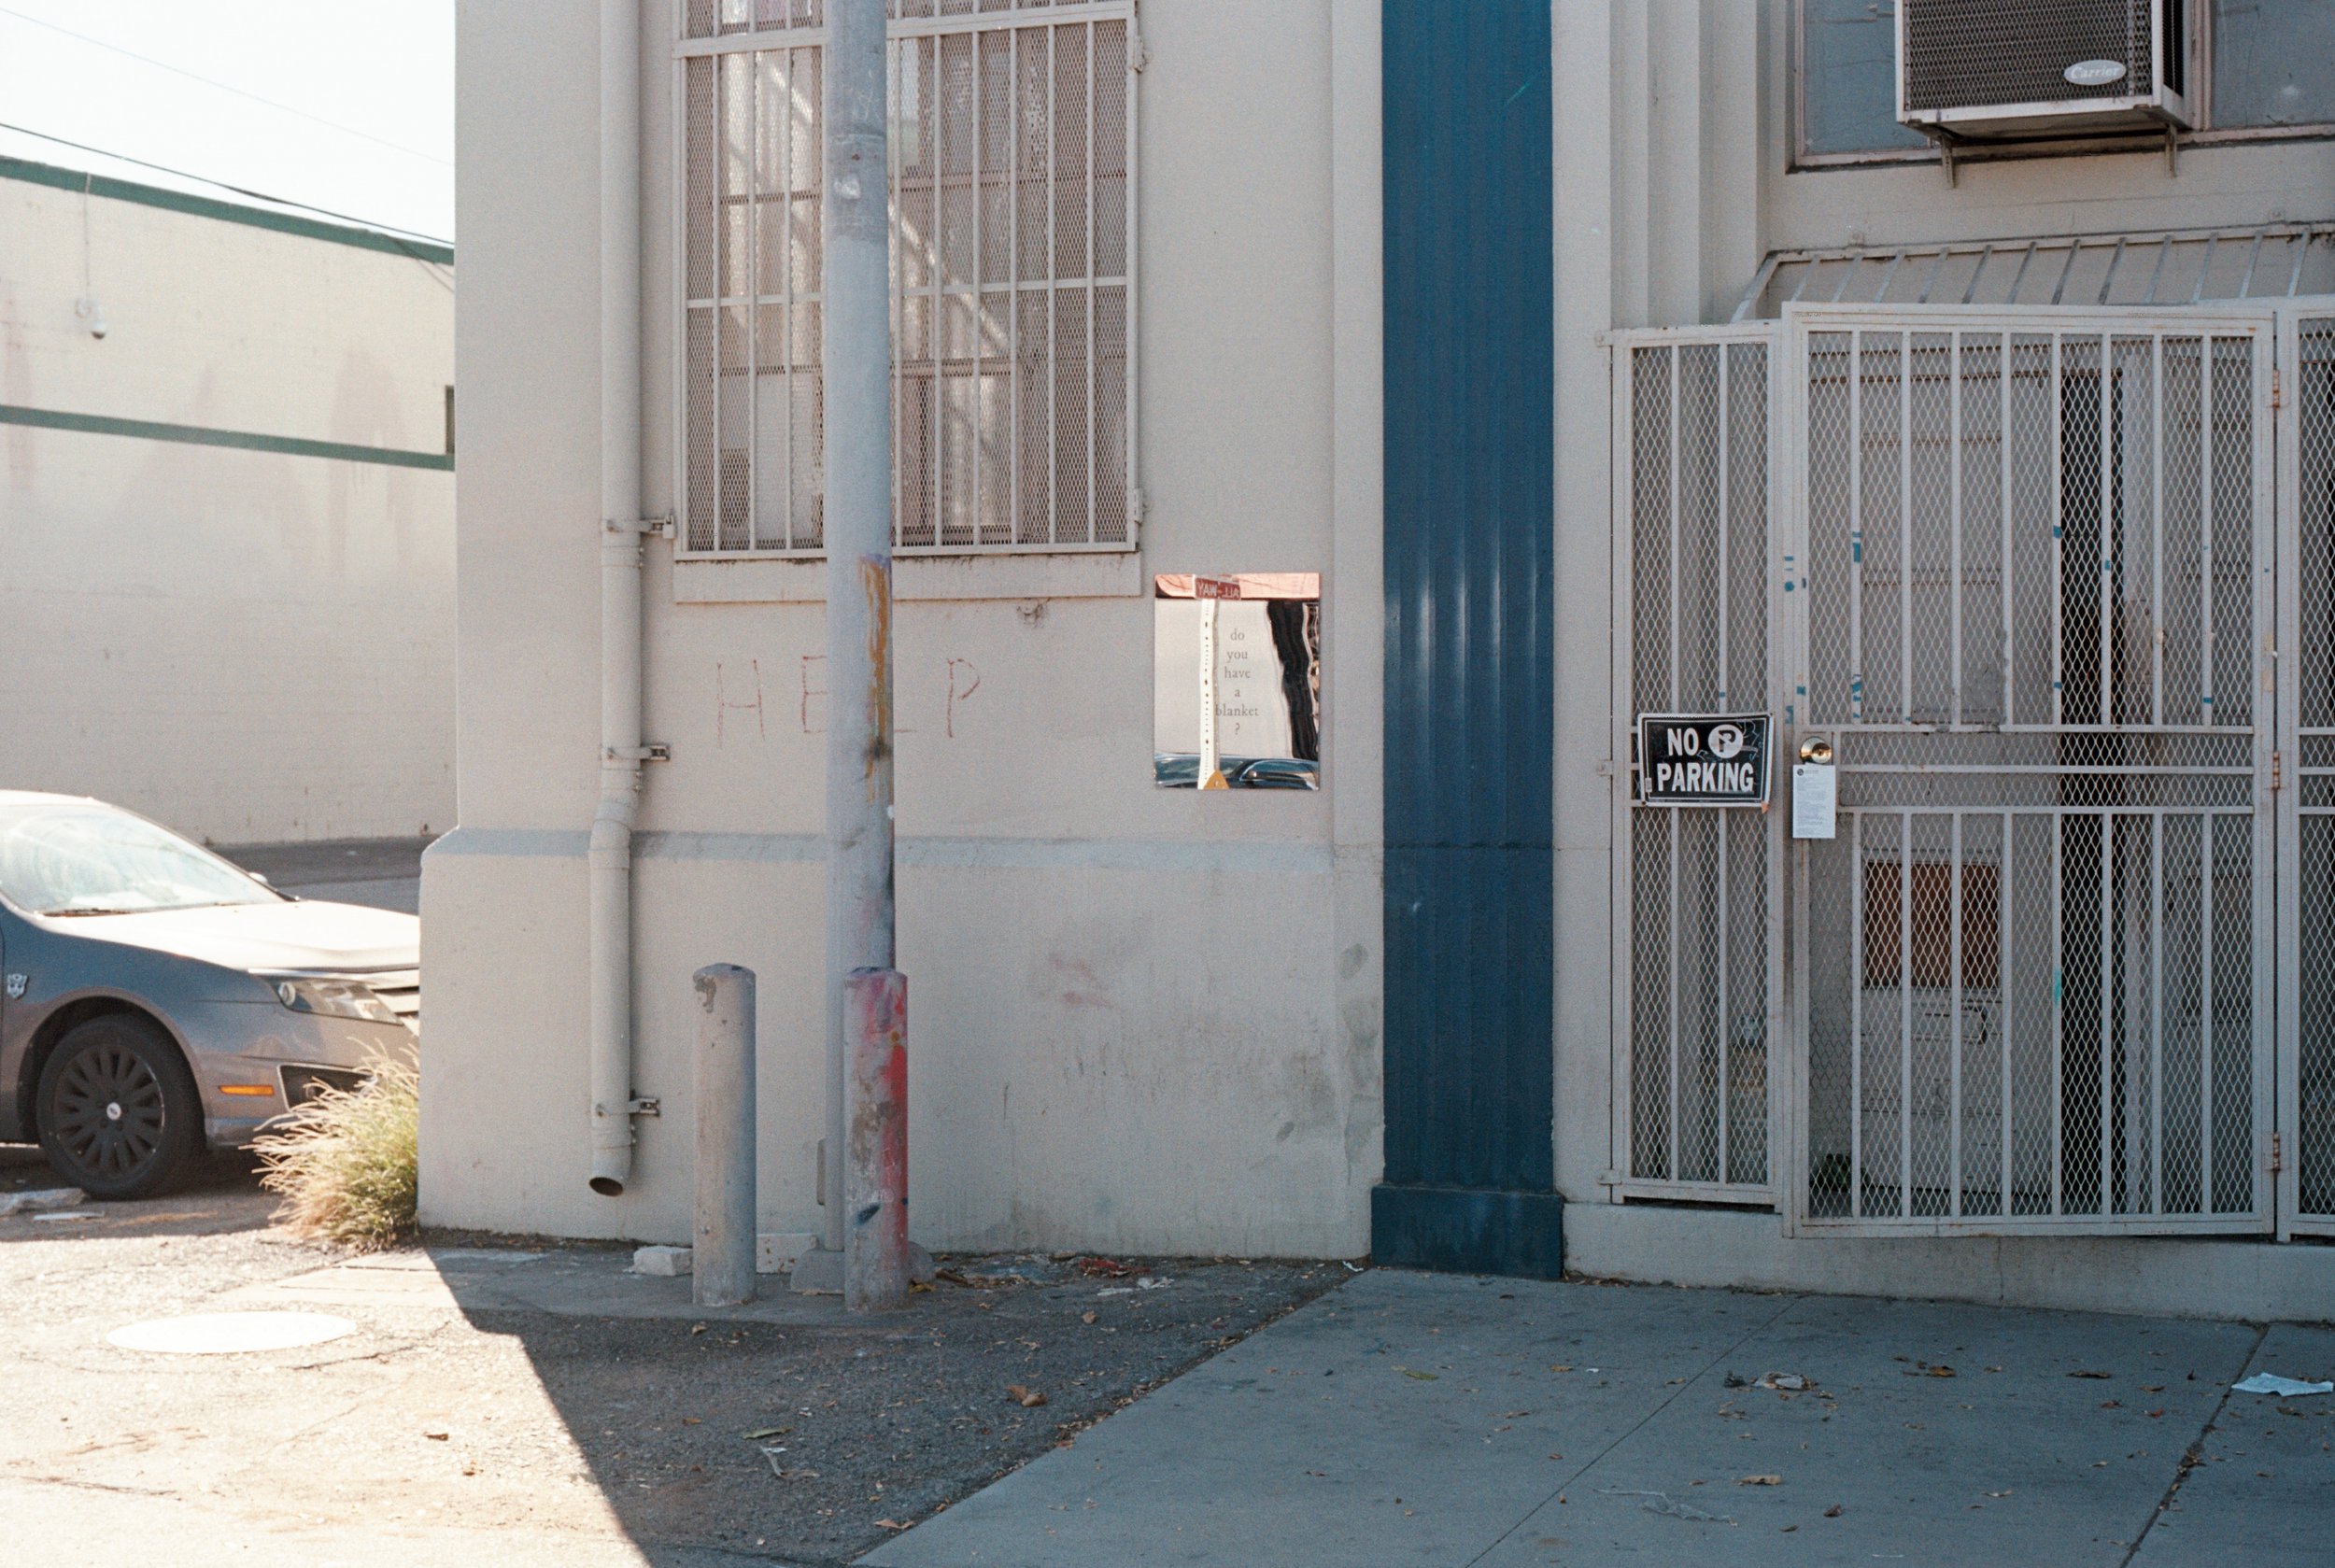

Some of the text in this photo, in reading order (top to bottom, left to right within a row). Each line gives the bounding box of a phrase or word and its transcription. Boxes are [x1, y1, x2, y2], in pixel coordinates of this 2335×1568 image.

[2071, 64, 2119, 78] Carrier
[1230, 628, 1245, 641] do
[1226, 651, 1248, 663] you
[1224, 666, 1252, 679] have
[1234, 688, 1241, 698] a
[716, 656, 981, 750] HEP
[1215, 703, 1260, 717] blanket
[1234, 723, 1241, 736] ?
[1666, 727, 1700, 757] NO
[1656, 761, 1755, 793] PARKING
